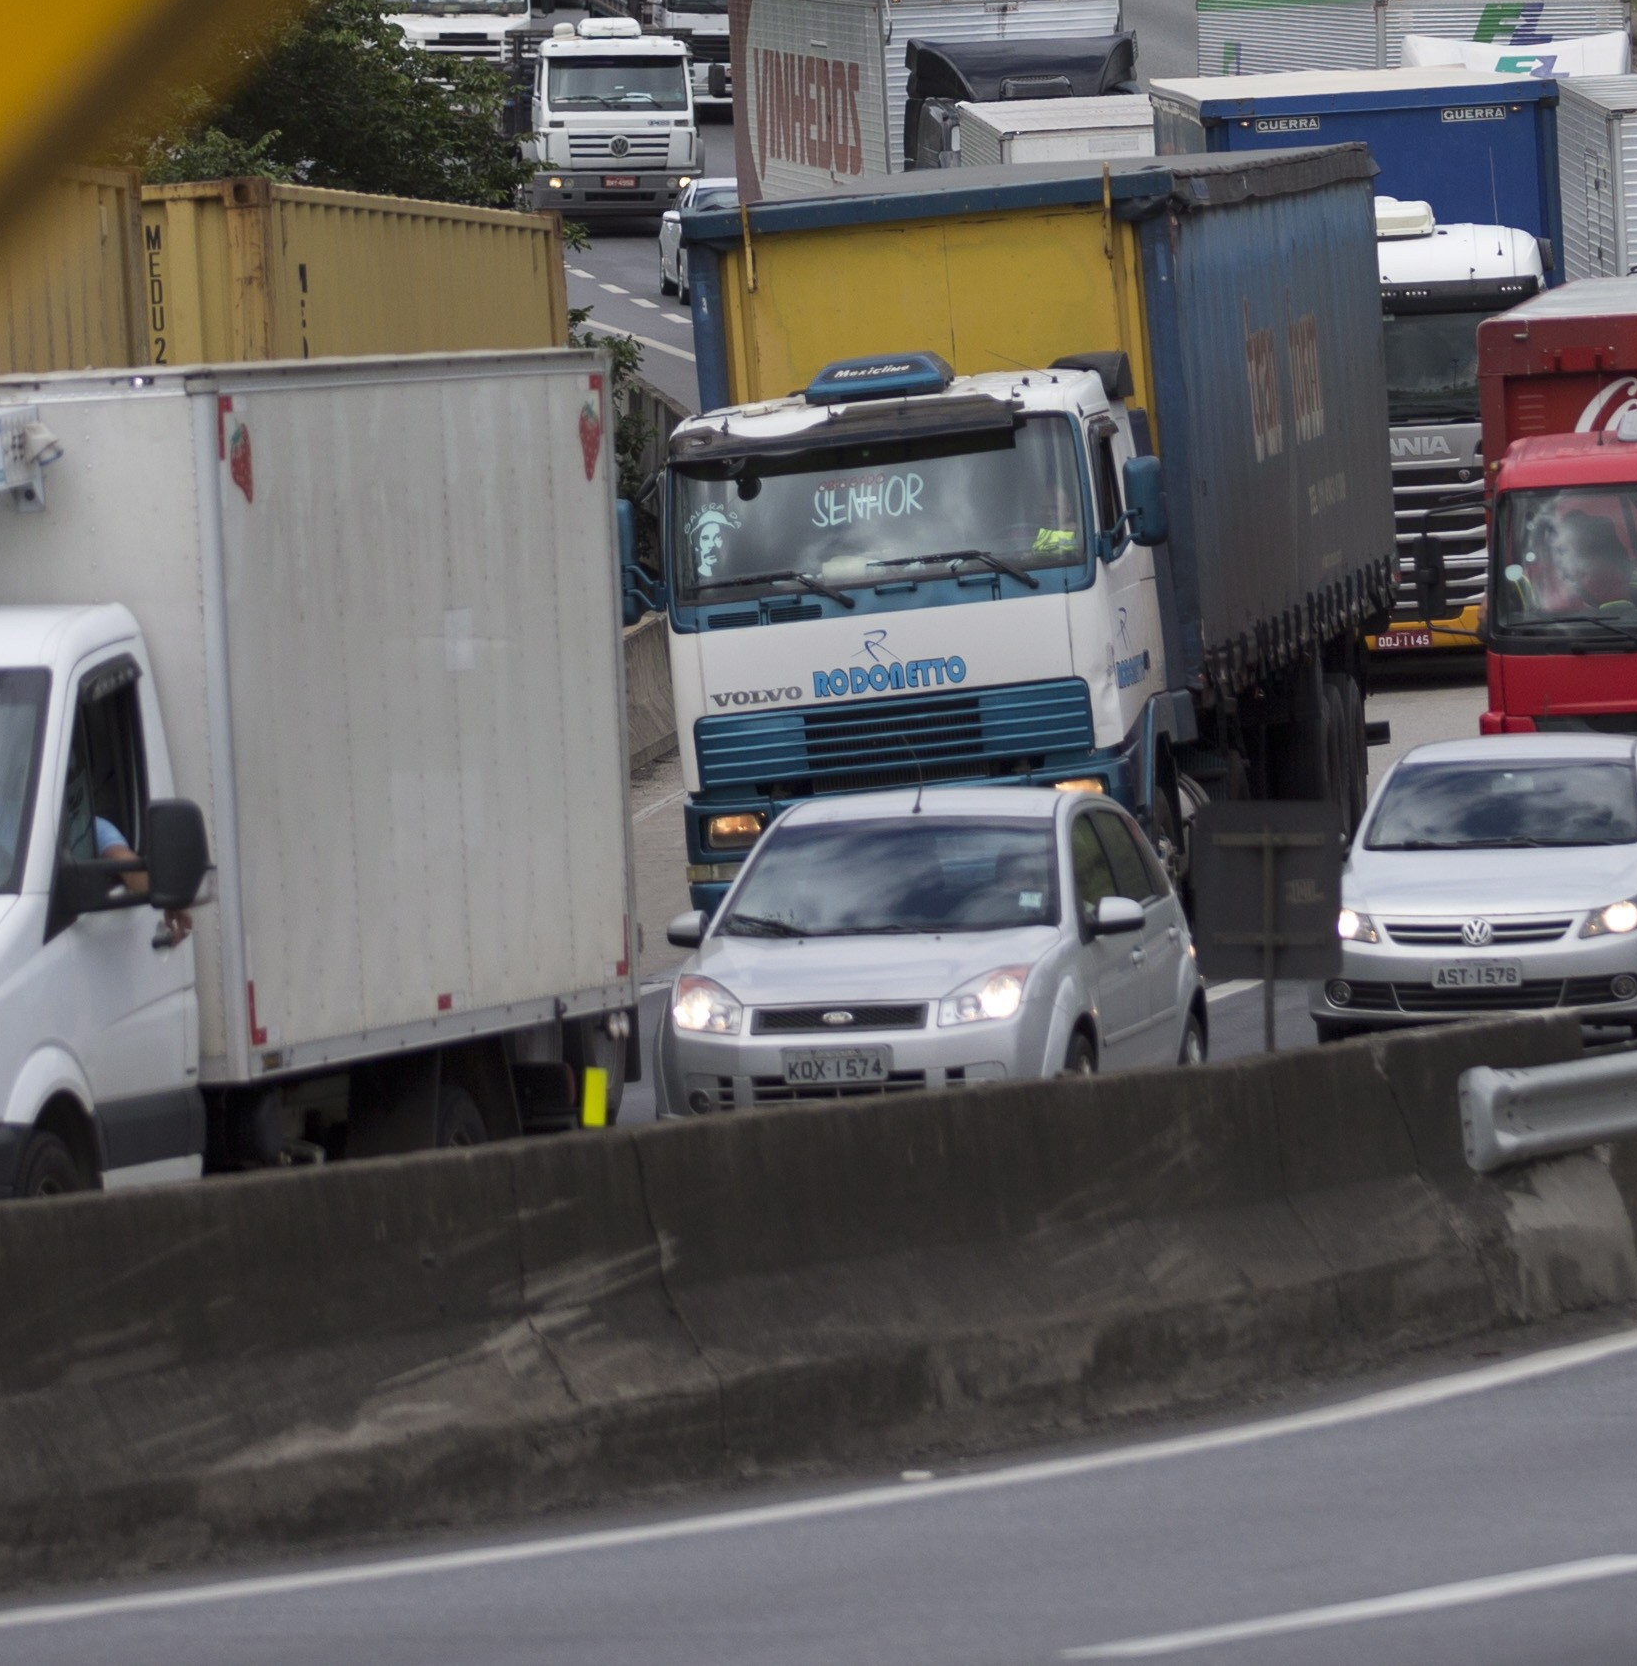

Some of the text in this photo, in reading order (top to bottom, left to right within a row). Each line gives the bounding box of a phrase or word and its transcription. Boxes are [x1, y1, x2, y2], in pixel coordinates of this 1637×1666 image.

[753, 47, 862, 181] VINHEDOS
[1258, 118, 1318, 131] GUERRA
[1443, 108, 1504, 120] GUERRA
[145, 224, 165, 332] MEDU
[1390, 435, 1451, 457] ANIA
[812, 473, 924, 528] SENHOR
[813, 655, 967, 698] RODONETTO
[710, 685, 803, 709] VOLVO
